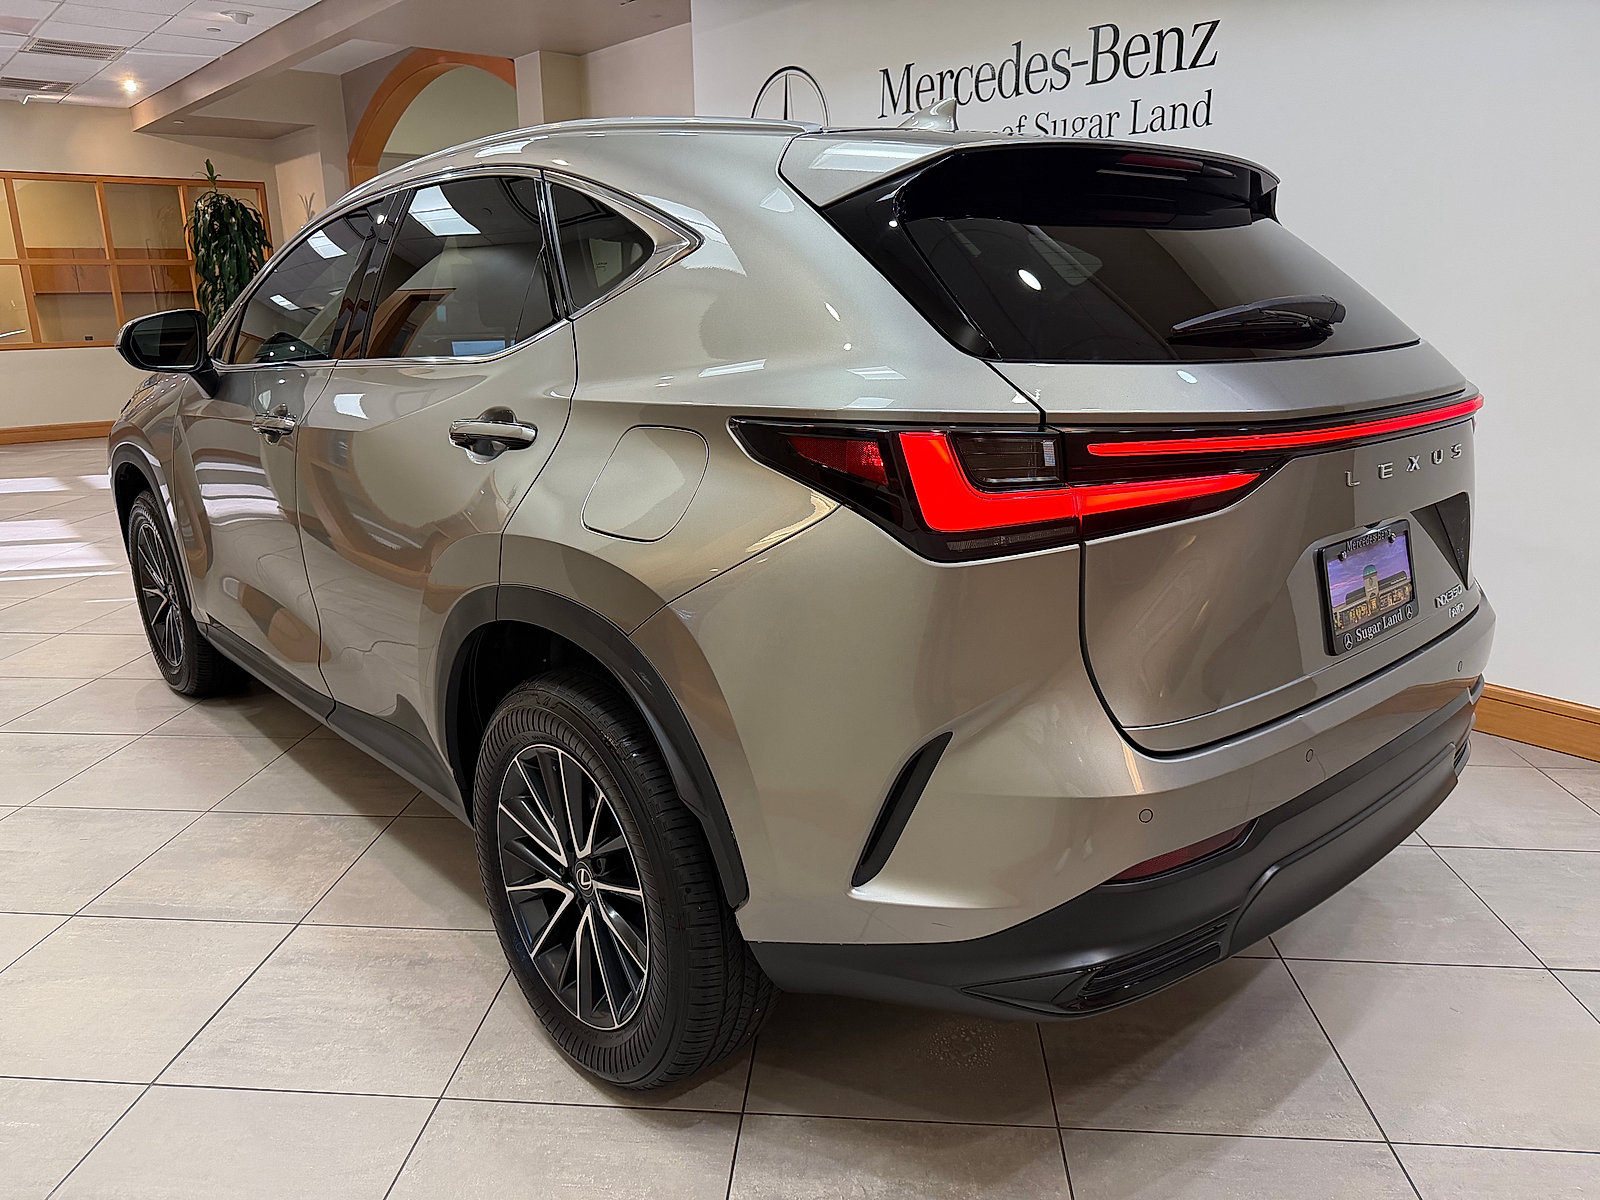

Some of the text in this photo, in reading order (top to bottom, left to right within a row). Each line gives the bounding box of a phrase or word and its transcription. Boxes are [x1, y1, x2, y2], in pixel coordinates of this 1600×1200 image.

[877, 19, 1222, 120] Mercedes-Benz
[1128, 88, 1214, 136] Land
[1344, 443, 1462, 487] LEXUS
[1355, 608, 1403, 640] Sugar Land
